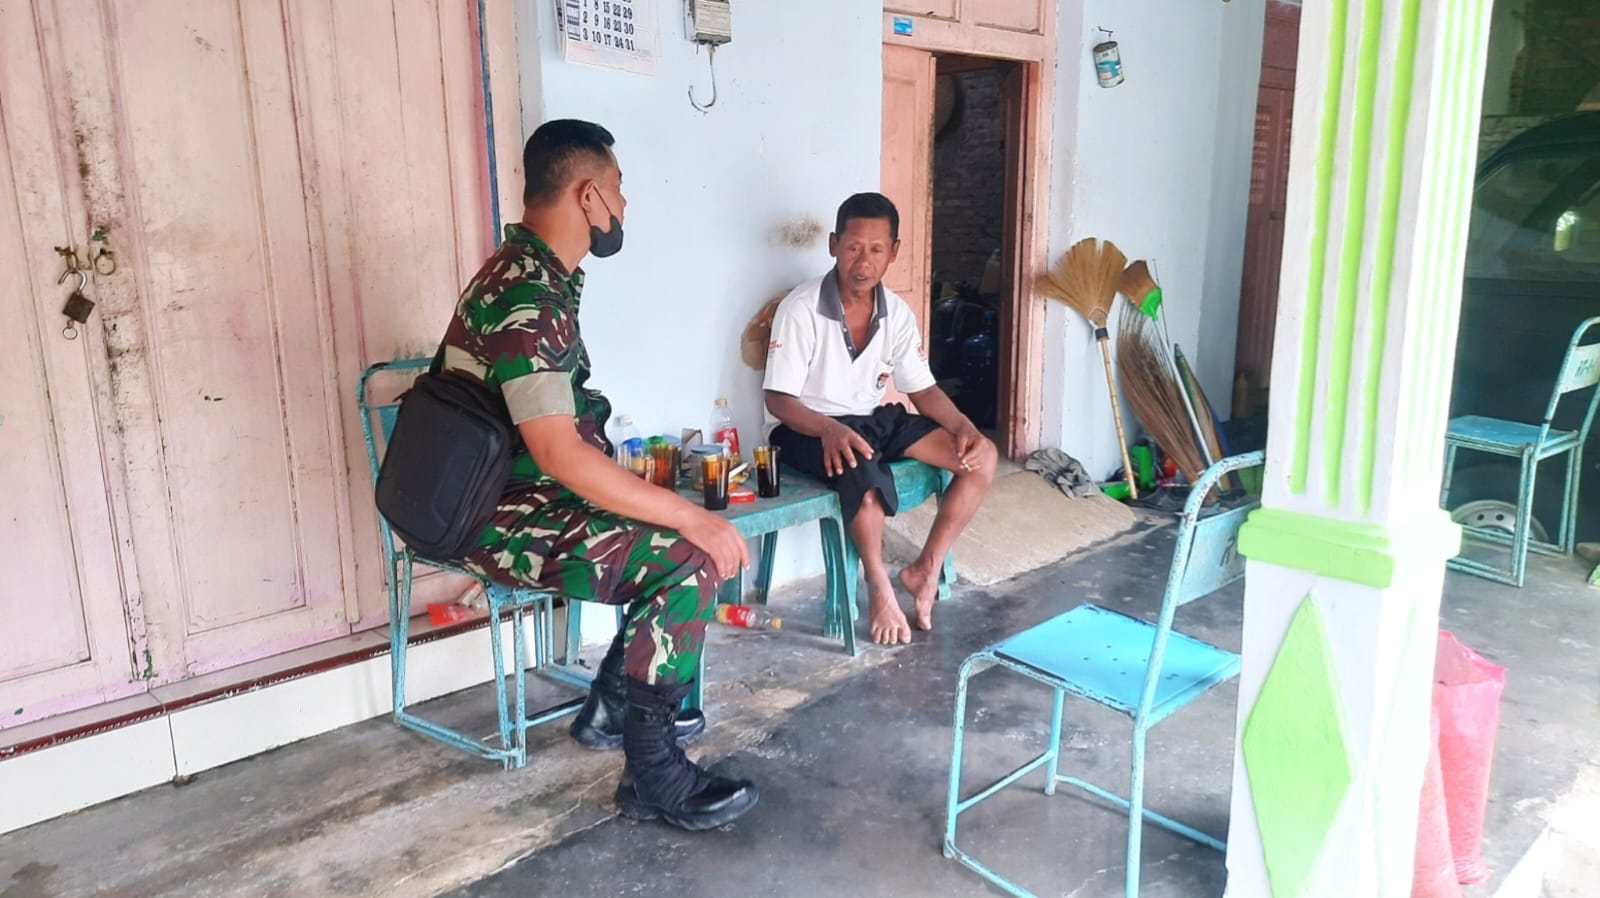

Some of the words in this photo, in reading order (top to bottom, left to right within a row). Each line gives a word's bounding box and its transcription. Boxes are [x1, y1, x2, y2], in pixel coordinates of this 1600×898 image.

[603, 1, 610, 13] 15
[613, 4, 620, 16] 22
[623, 7, 632, 19] 29
[583, 11, 588, 23] 2
[594, 14, 599, 26] 9
[604, 17, 611, 30] 16
[613, 20, 622, 32] 23
[624, 22, 634, 35] 30
[583, 28, 588, 40] 3
[592, 31, 601, 43] 10
[604, 34, 611, 46] 17
[614, 36, 624, 48] 24
[625, 39, 635, 51] 31
